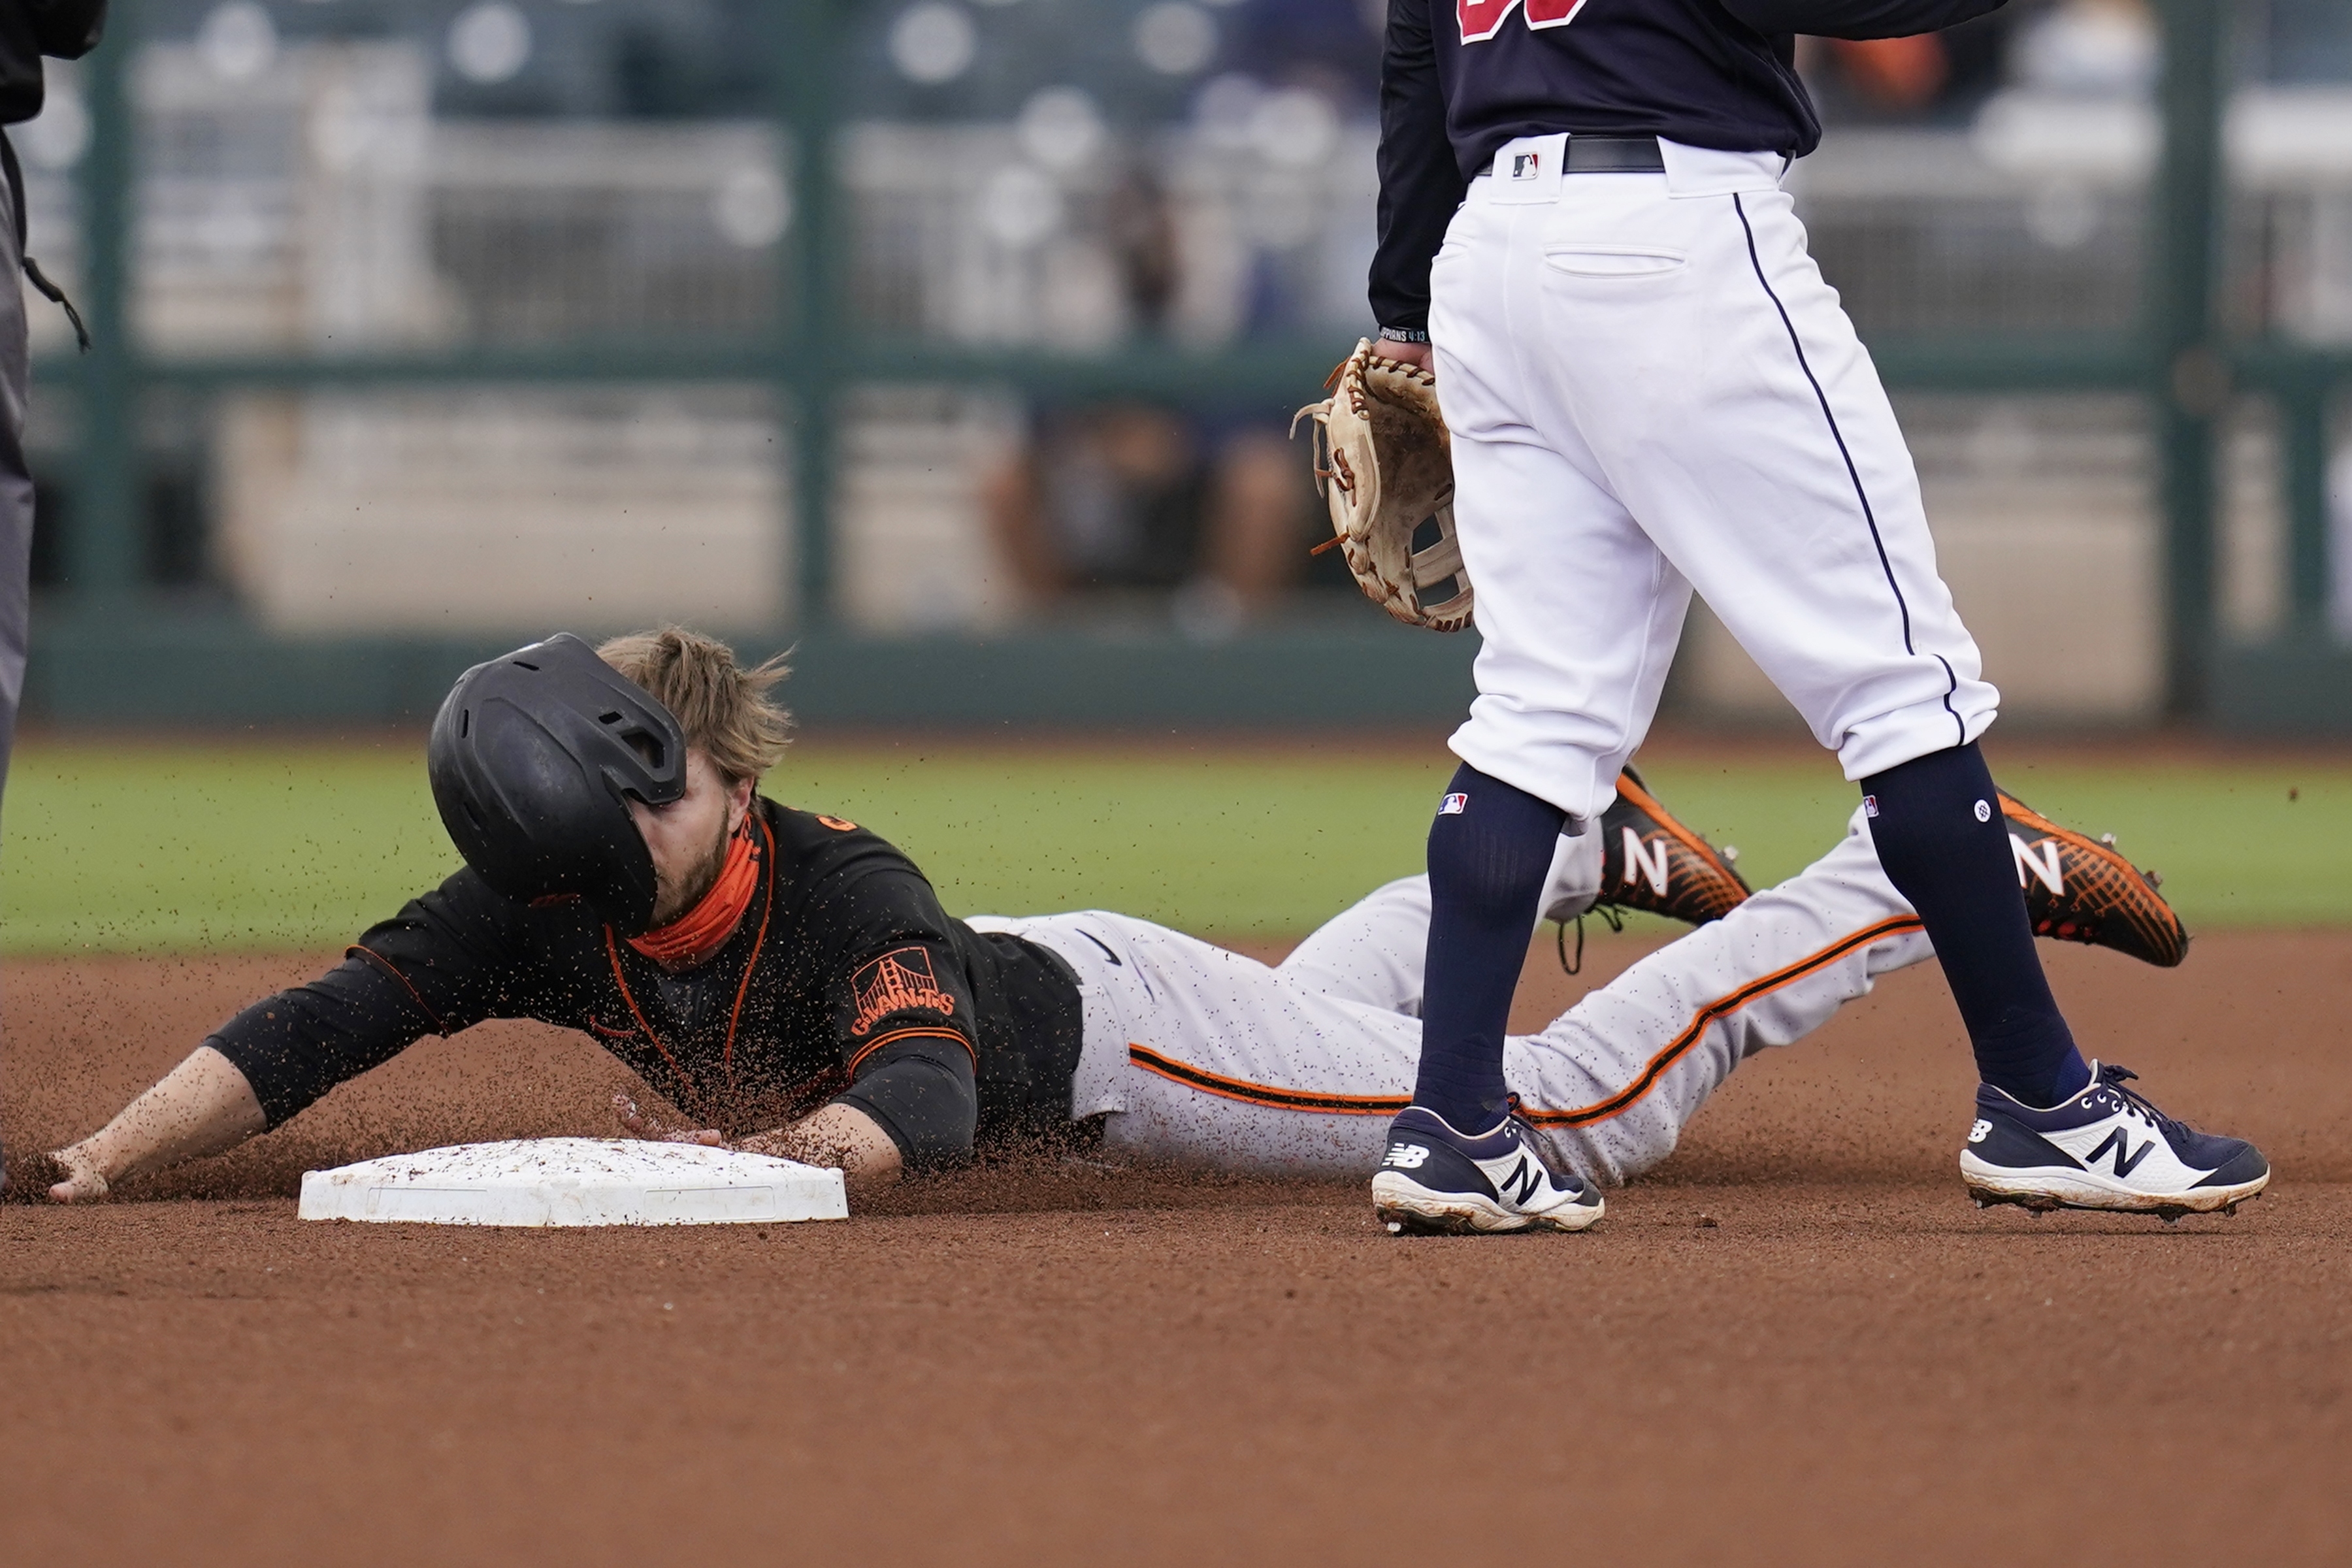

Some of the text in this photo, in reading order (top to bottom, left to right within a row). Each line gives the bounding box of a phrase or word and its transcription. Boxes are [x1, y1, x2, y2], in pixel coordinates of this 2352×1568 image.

[1408, 330, 1426, 342] 4:13
[1622, 826, 1669, 898] N
[2085, 1126, 2156, 1179] N
[1501, 1154, 1543, 1206] N
